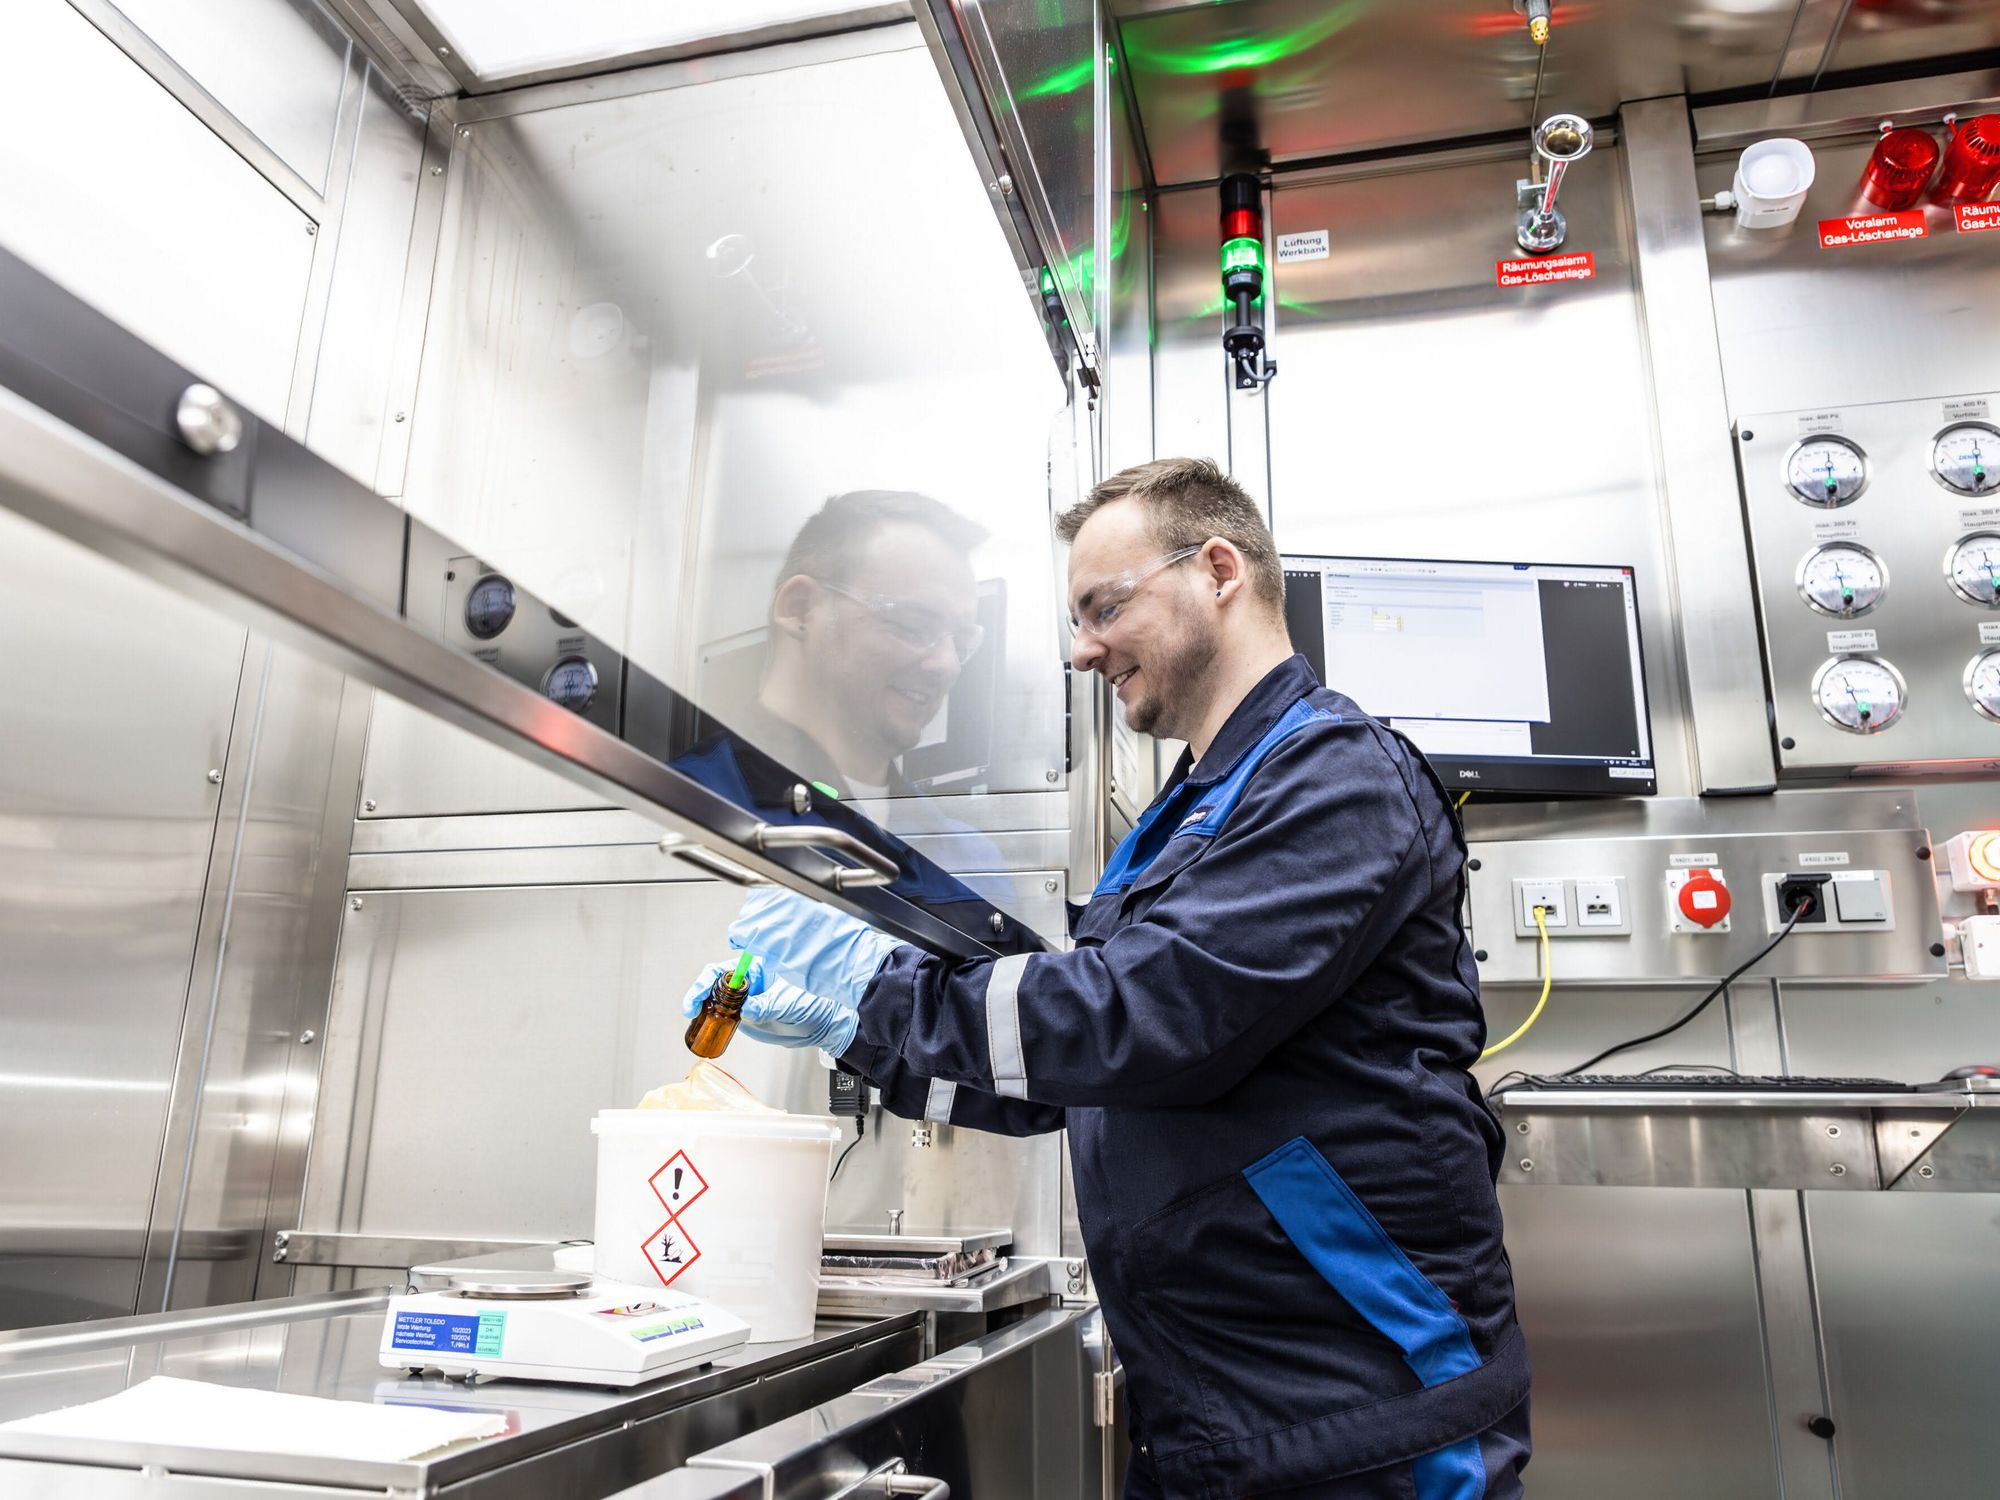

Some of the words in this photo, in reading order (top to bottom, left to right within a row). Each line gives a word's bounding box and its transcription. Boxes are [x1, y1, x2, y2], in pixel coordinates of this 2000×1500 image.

[1846, 216, 1897, 229] Voralarm
[1283, 237, 1322, 247] Lüftung
[1824, 227, 1923, 245] Gas-Löschanlage
[1279, 246, 1327, 257] Werkbank
[1502, 256, 1587, 273] Räumungsalarm
[1501, 267, 1592, 285] Gas-Löschanlage
[1459, 770, 1480, 779] DELL
[398, 1316, 422, 1324] METTLER
[423, 1317, 446, 1325] TOLEDO
